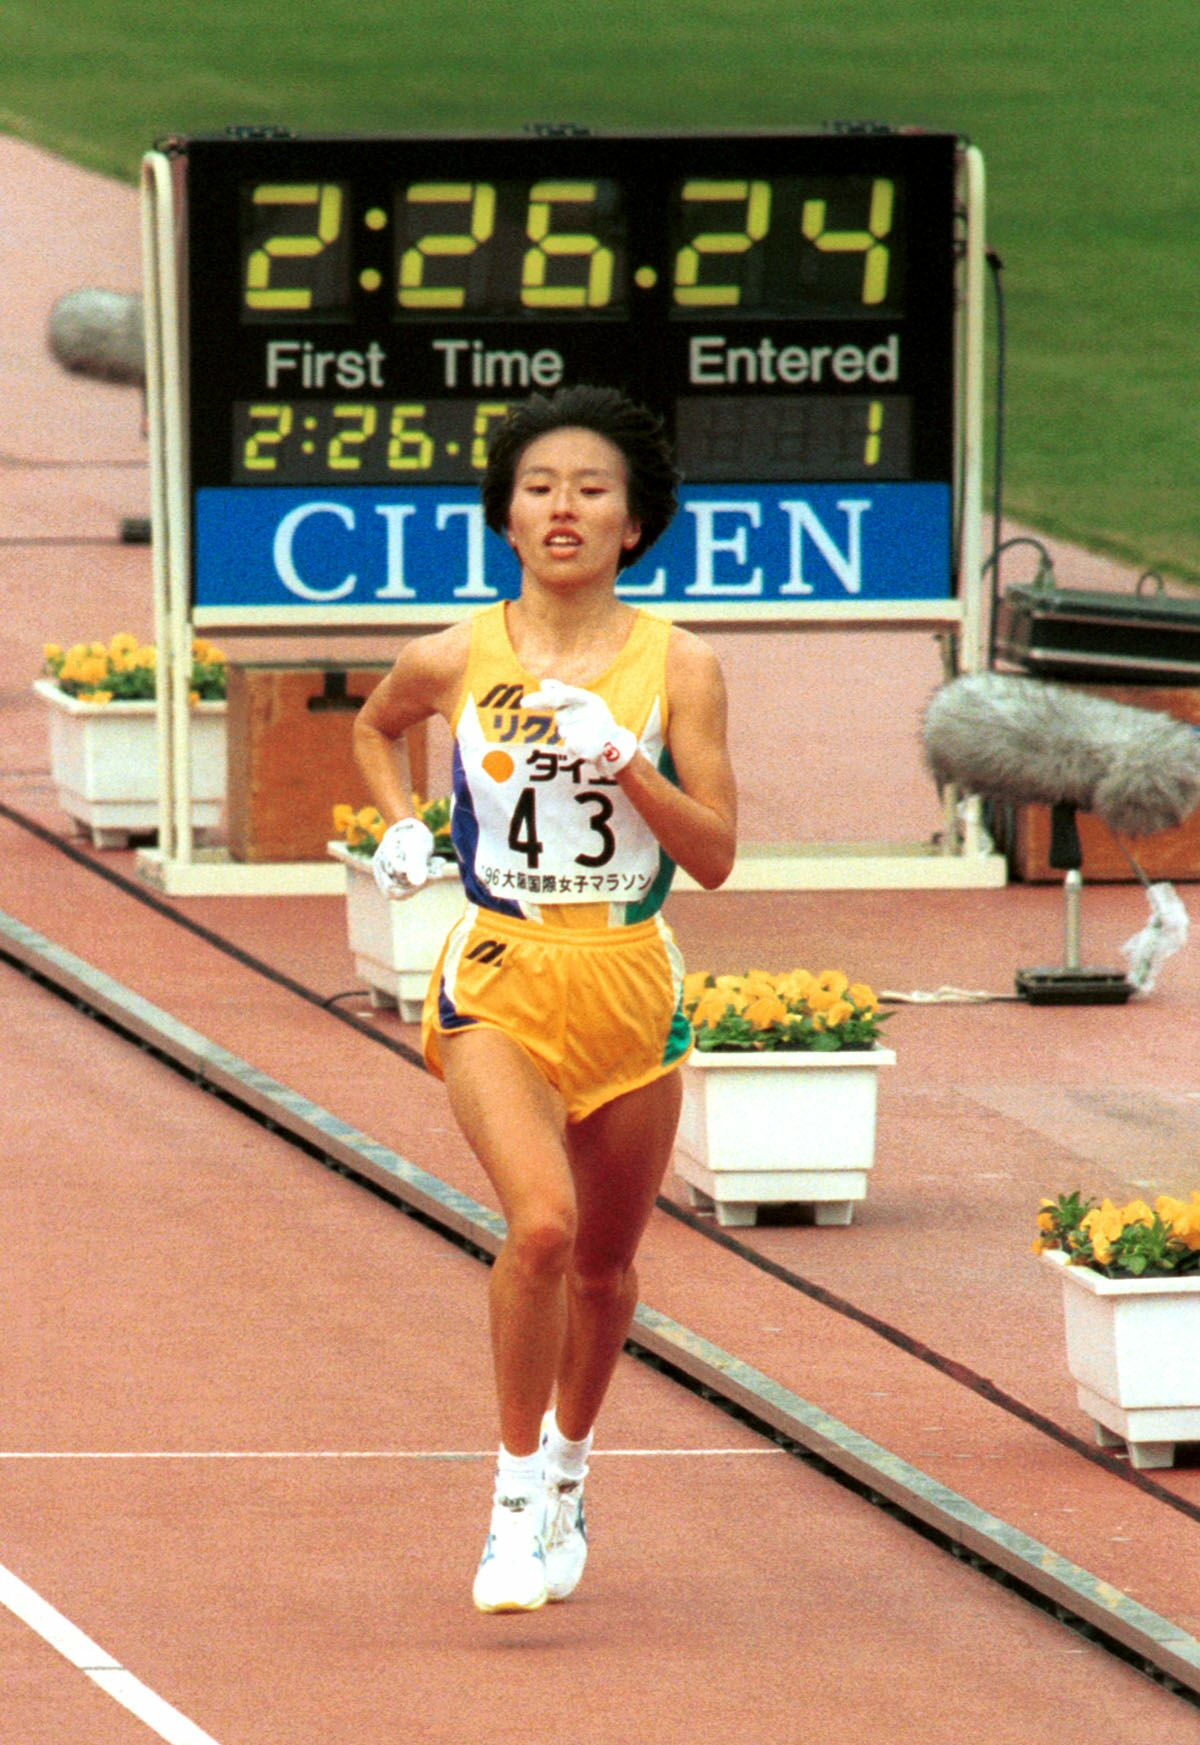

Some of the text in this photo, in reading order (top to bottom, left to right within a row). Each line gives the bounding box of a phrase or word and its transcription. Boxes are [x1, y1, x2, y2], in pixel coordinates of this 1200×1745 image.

[267, 335, 899, 388] First Time Entered
[864, 401, 883, 466] 1
[273, 499, 870, 600] CITEN
[494, 714, 561, 744] リク
[508, 788, 615, 869] 43
